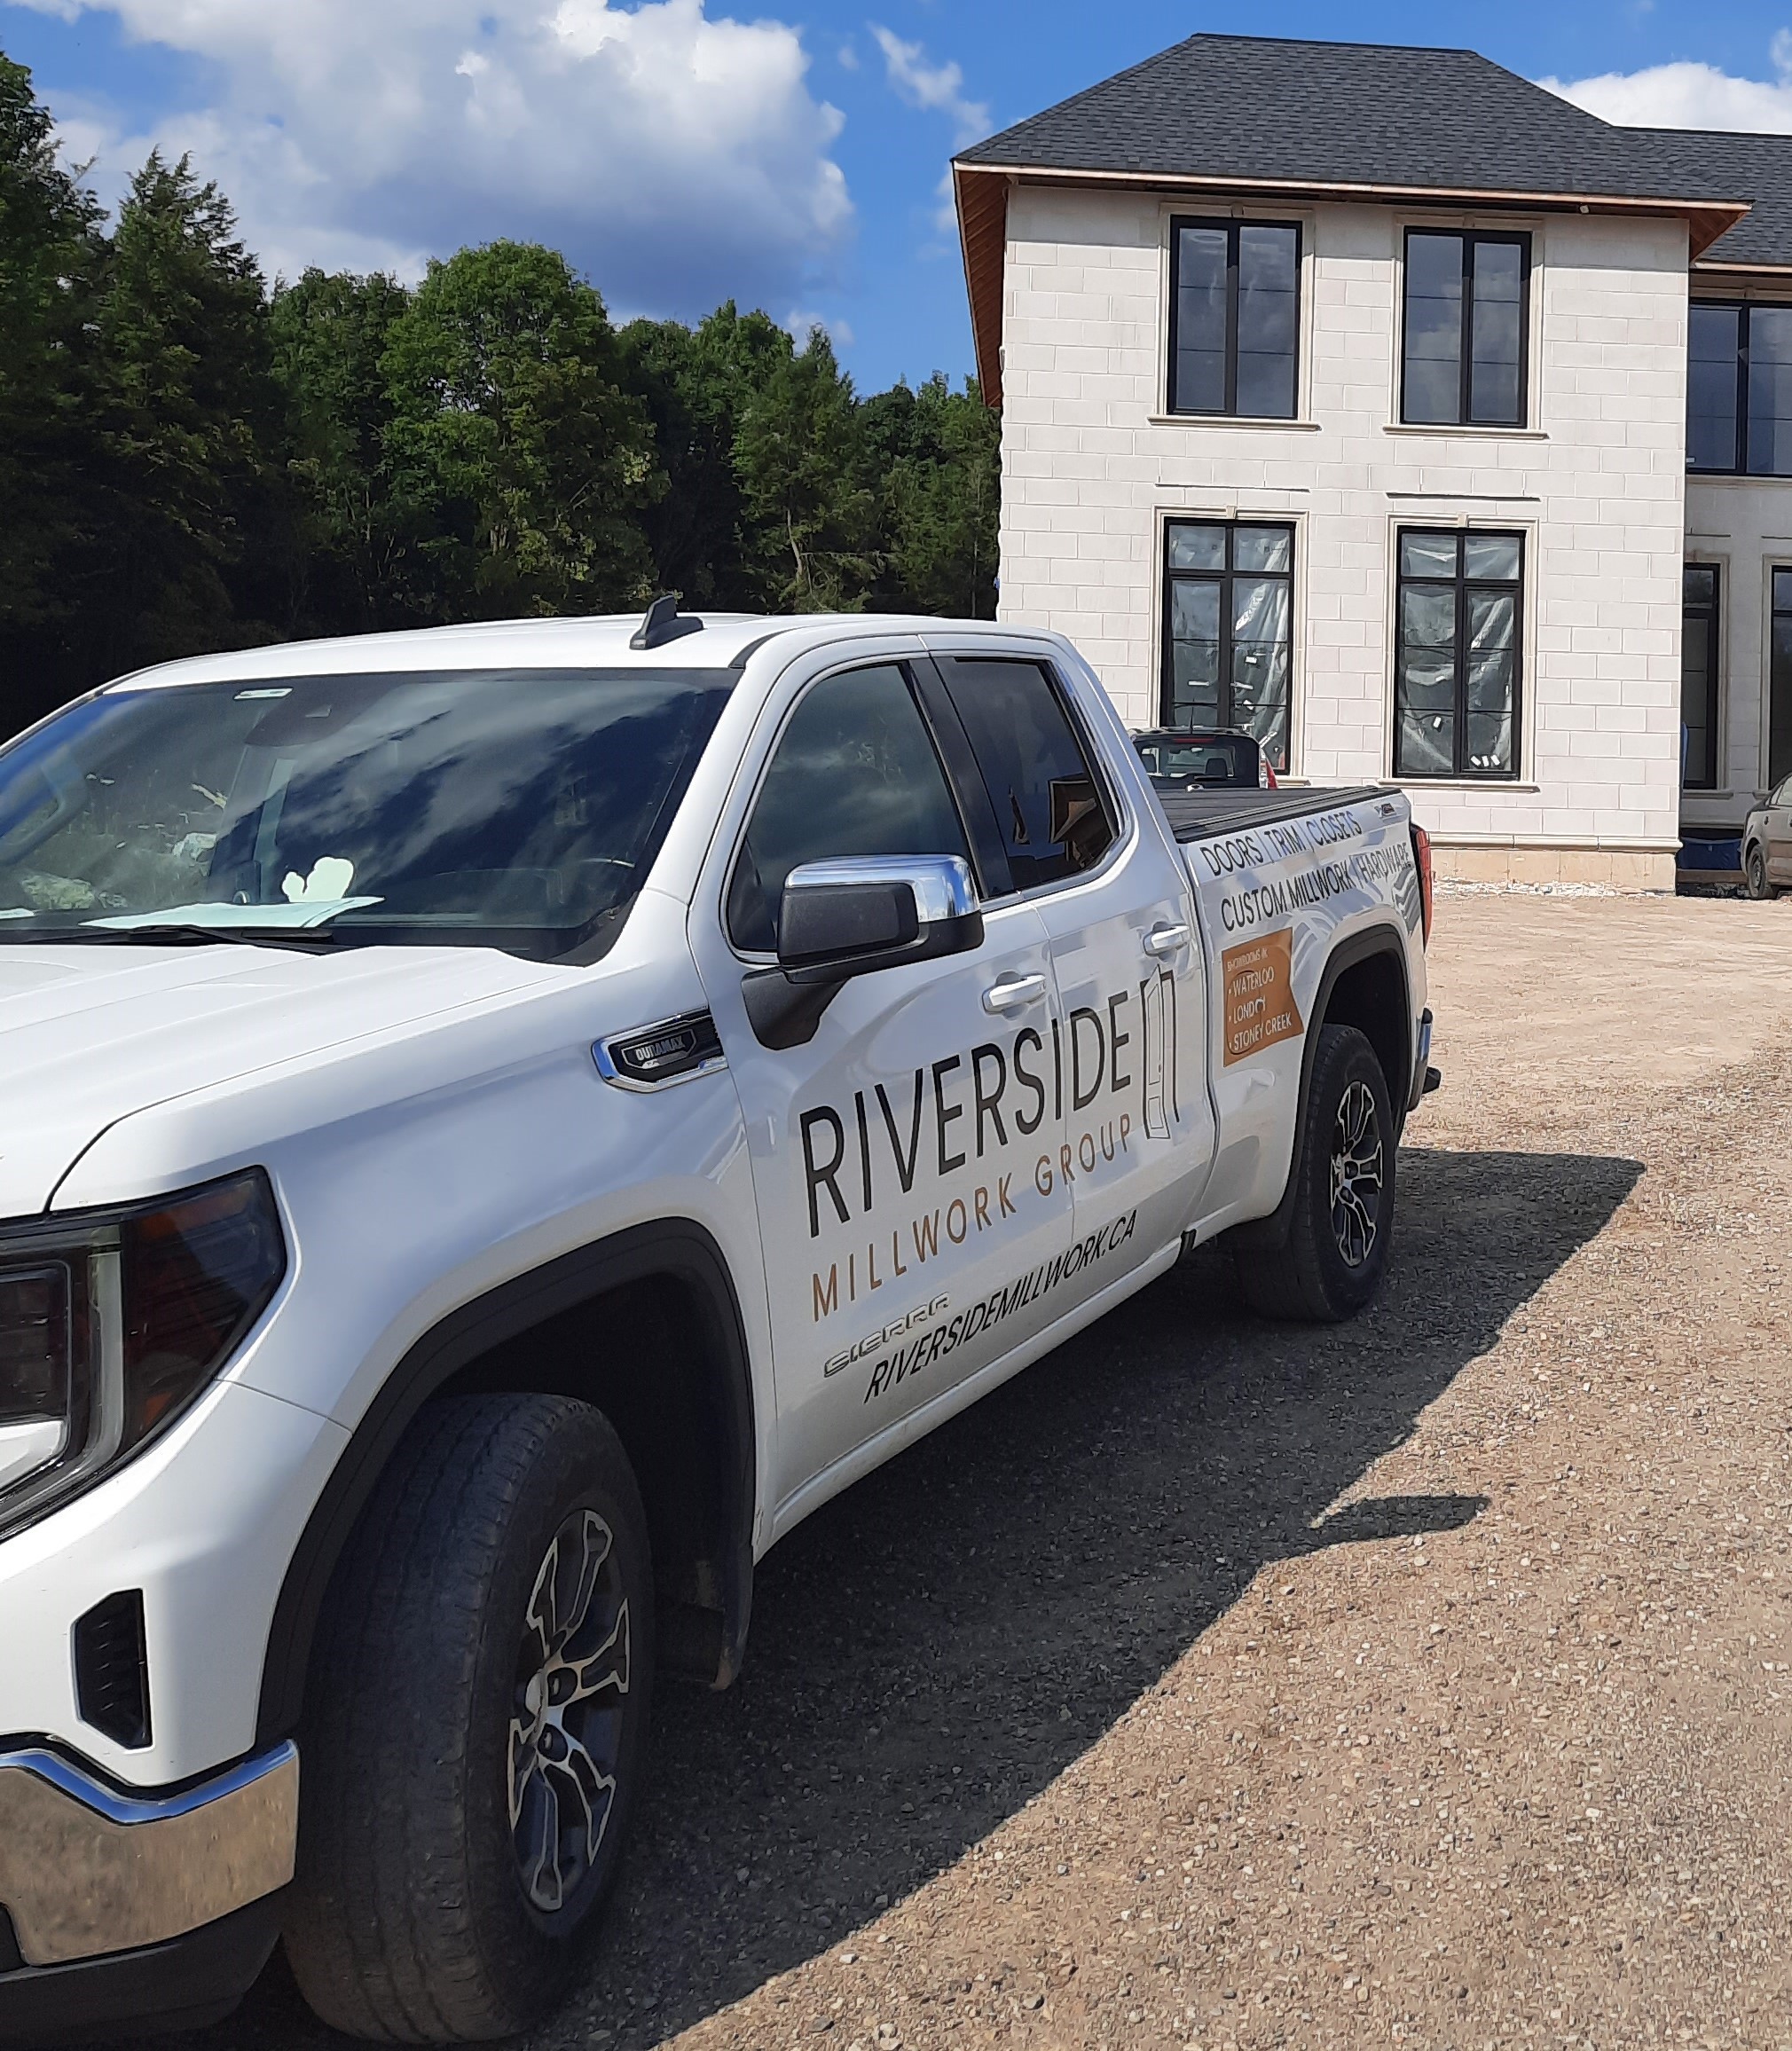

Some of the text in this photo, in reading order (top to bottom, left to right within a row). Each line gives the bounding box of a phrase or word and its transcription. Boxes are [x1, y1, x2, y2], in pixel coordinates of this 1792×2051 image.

[1200, 835, 1264, 876] DOORS
[1264, 825, 1307, 858] TRIM
[1306, 810, 1363, 846] CLOSETS
[1221, 880, 1287, 932] CUSTOM
[1286, 859, 1357, 909] MILLWORK
[1233, 966, 1275, 998] WATERLOO
[1234, 1012, 1293, 1051] STONEY CREEK
[799, 990, 1132, 1238] RIVERSIDE
[813, 1113, 1131, 1323] MILLWORK GROUP
[823, 1292, 951, 1379] SIERRA
[863, 1209, 1138, 1405] RIVERSIDEMILLWORK.CA
